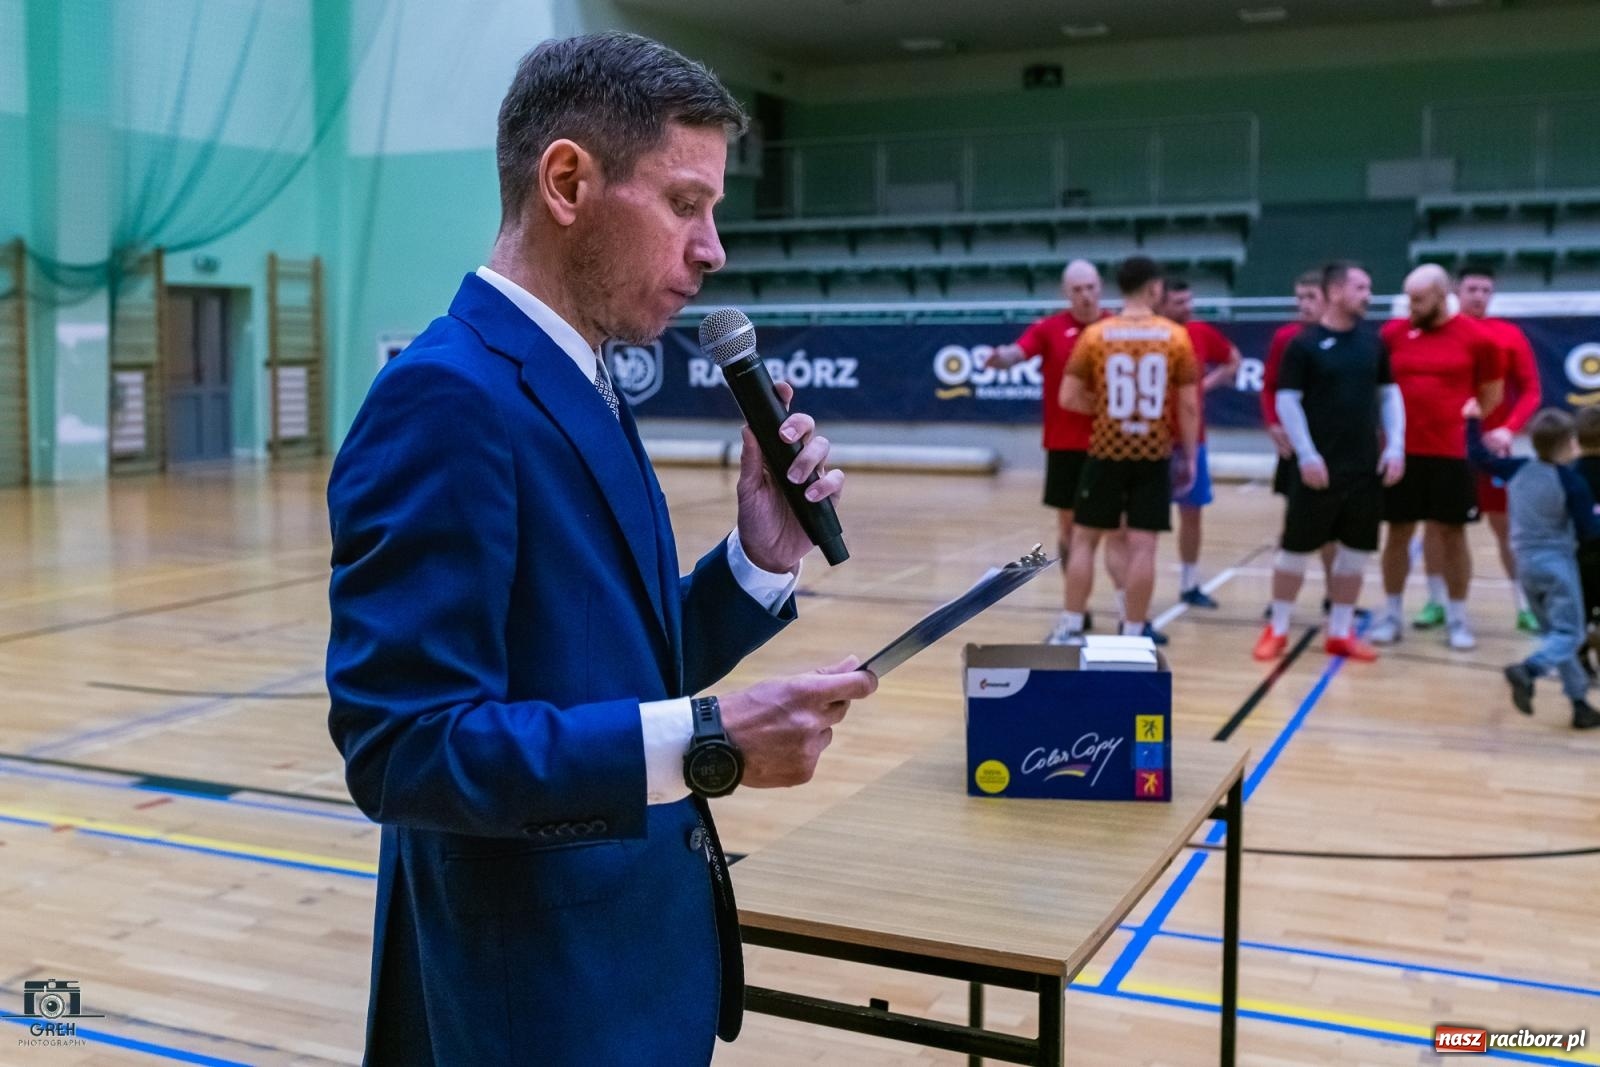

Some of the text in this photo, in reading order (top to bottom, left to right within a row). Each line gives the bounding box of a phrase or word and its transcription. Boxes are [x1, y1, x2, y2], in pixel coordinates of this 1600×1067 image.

[1106, 353, 1168, 420] 69
[1021, 732, 1124, 787] Color Copy
